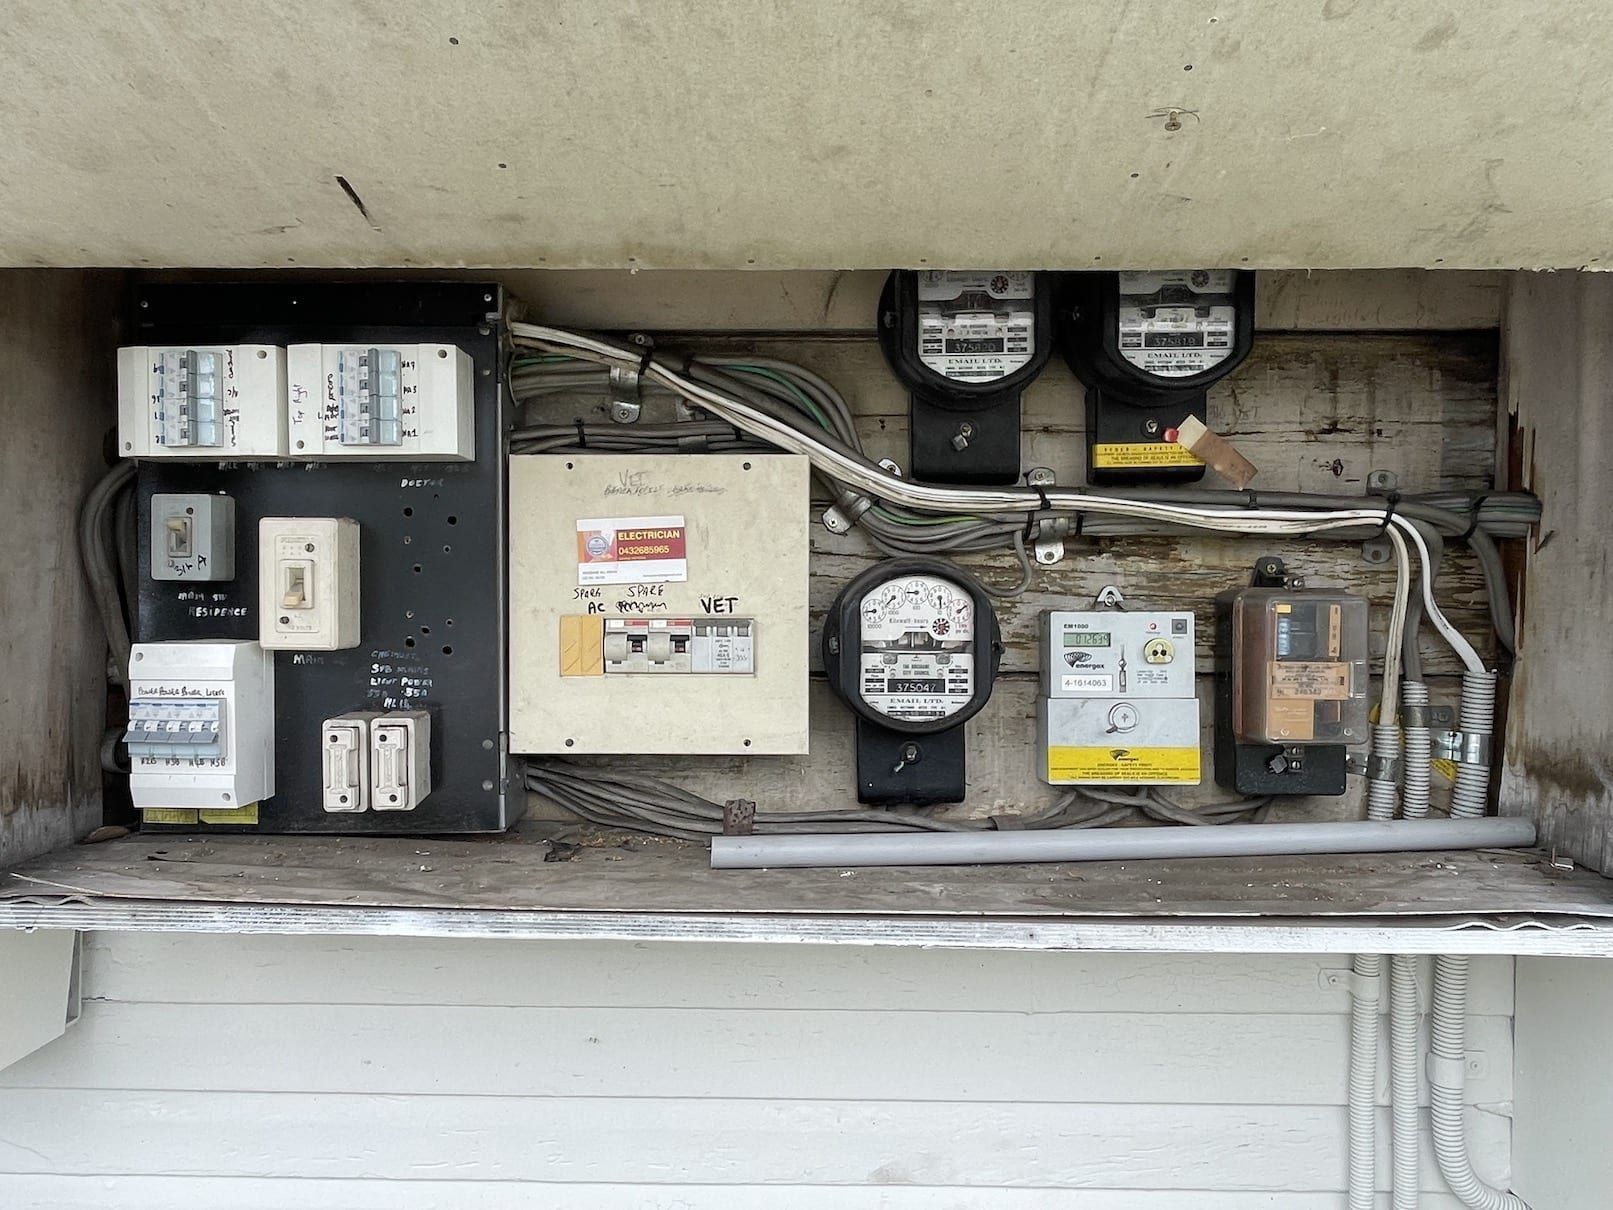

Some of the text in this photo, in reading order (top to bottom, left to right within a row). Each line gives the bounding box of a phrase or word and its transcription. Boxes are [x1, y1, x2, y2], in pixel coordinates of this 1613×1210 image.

[617, 531, 681, 541] ELECTRICIAN
[618, 545, 670, 556] 0432685965
[588, 601, 606, 615] AC
[699, 596, 739, 615] VET
[189, 606, 248, 617] RESIDENCE
[895, 683, 937, 693] 375047
